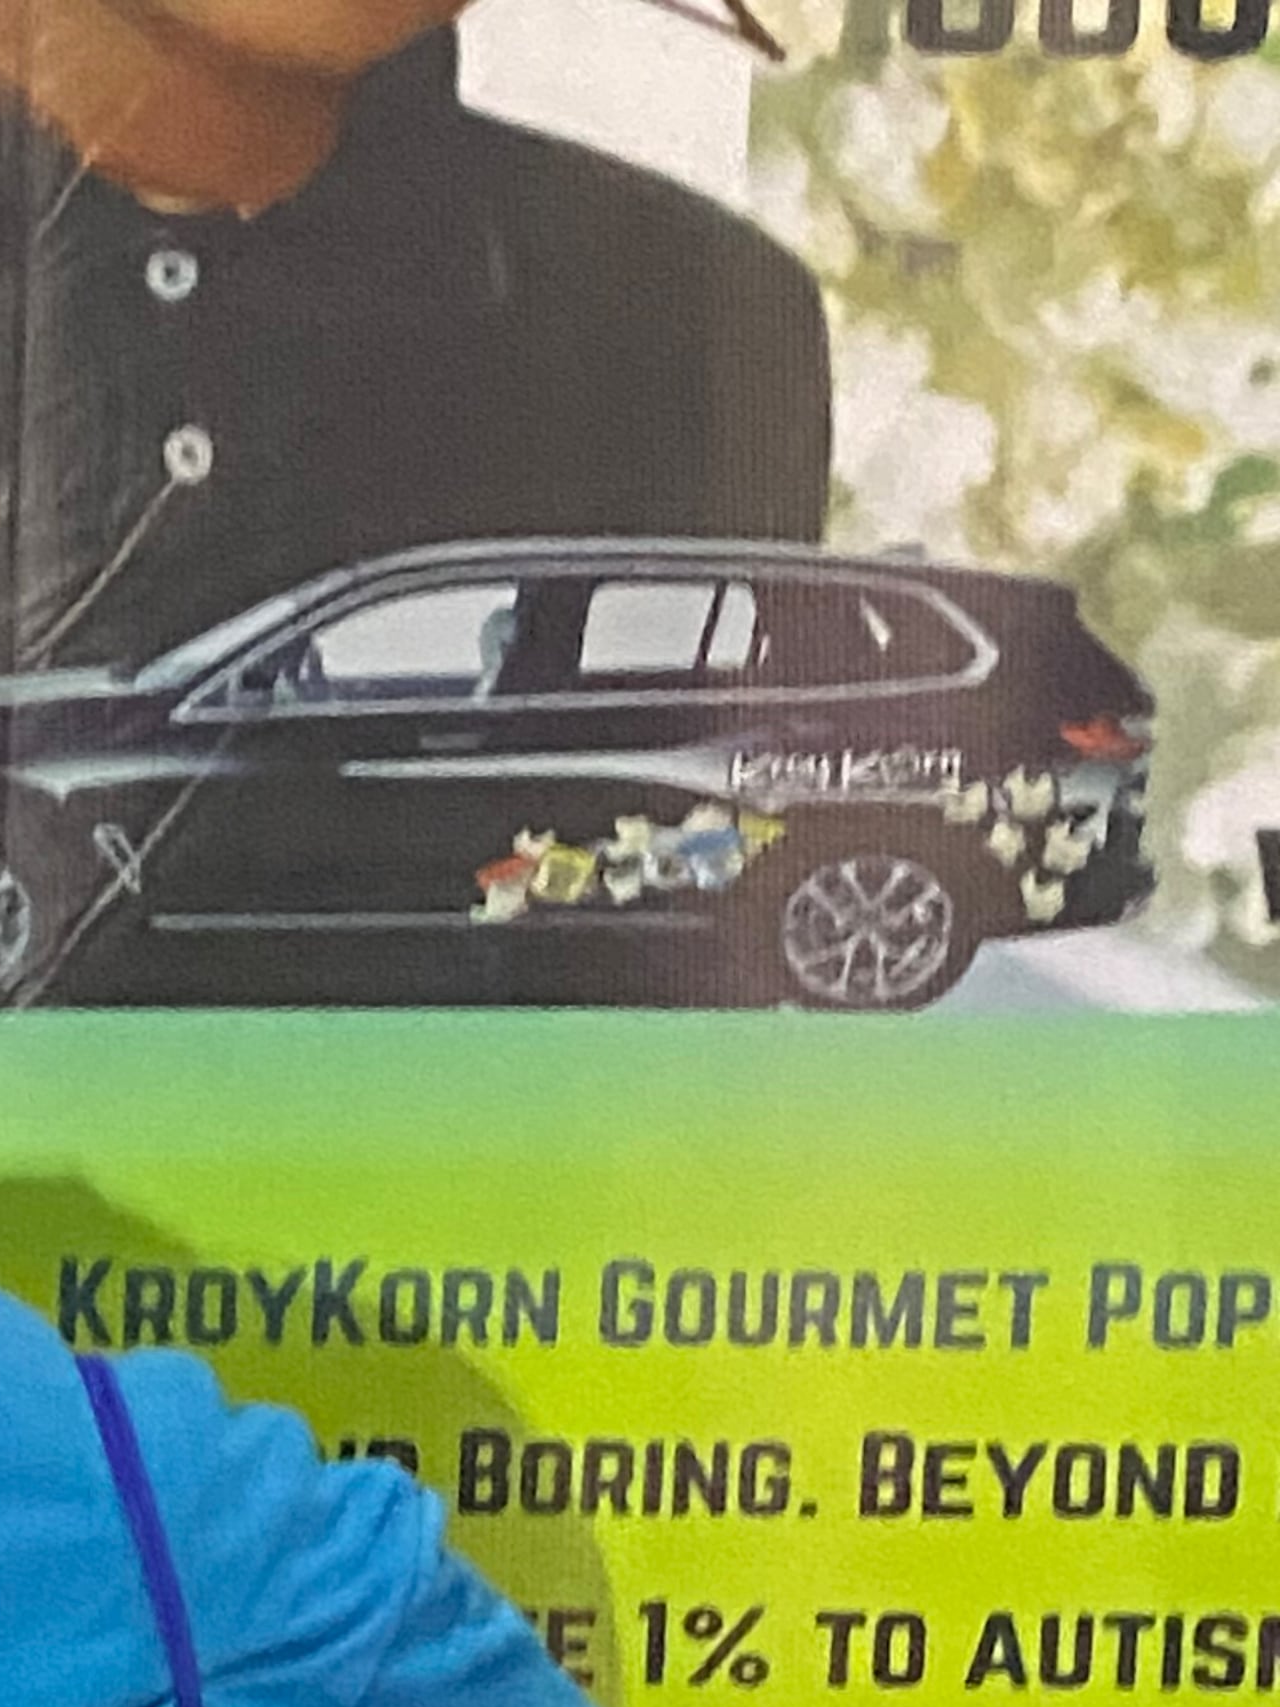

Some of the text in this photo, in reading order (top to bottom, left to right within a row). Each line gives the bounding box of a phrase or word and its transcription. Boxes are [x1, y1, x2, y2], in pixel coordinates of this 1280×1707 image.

[598, 1257, 1050, 1350] GOURMET
[1086, 1261, 1272, 1350] POP
[457, 1427, 818, 1518] BORING.
[859, 1430, 1241, 1519] BEYOND
[640, 1600, 770, 1690] 1%
[815, 1611, 927, 1690] TO
